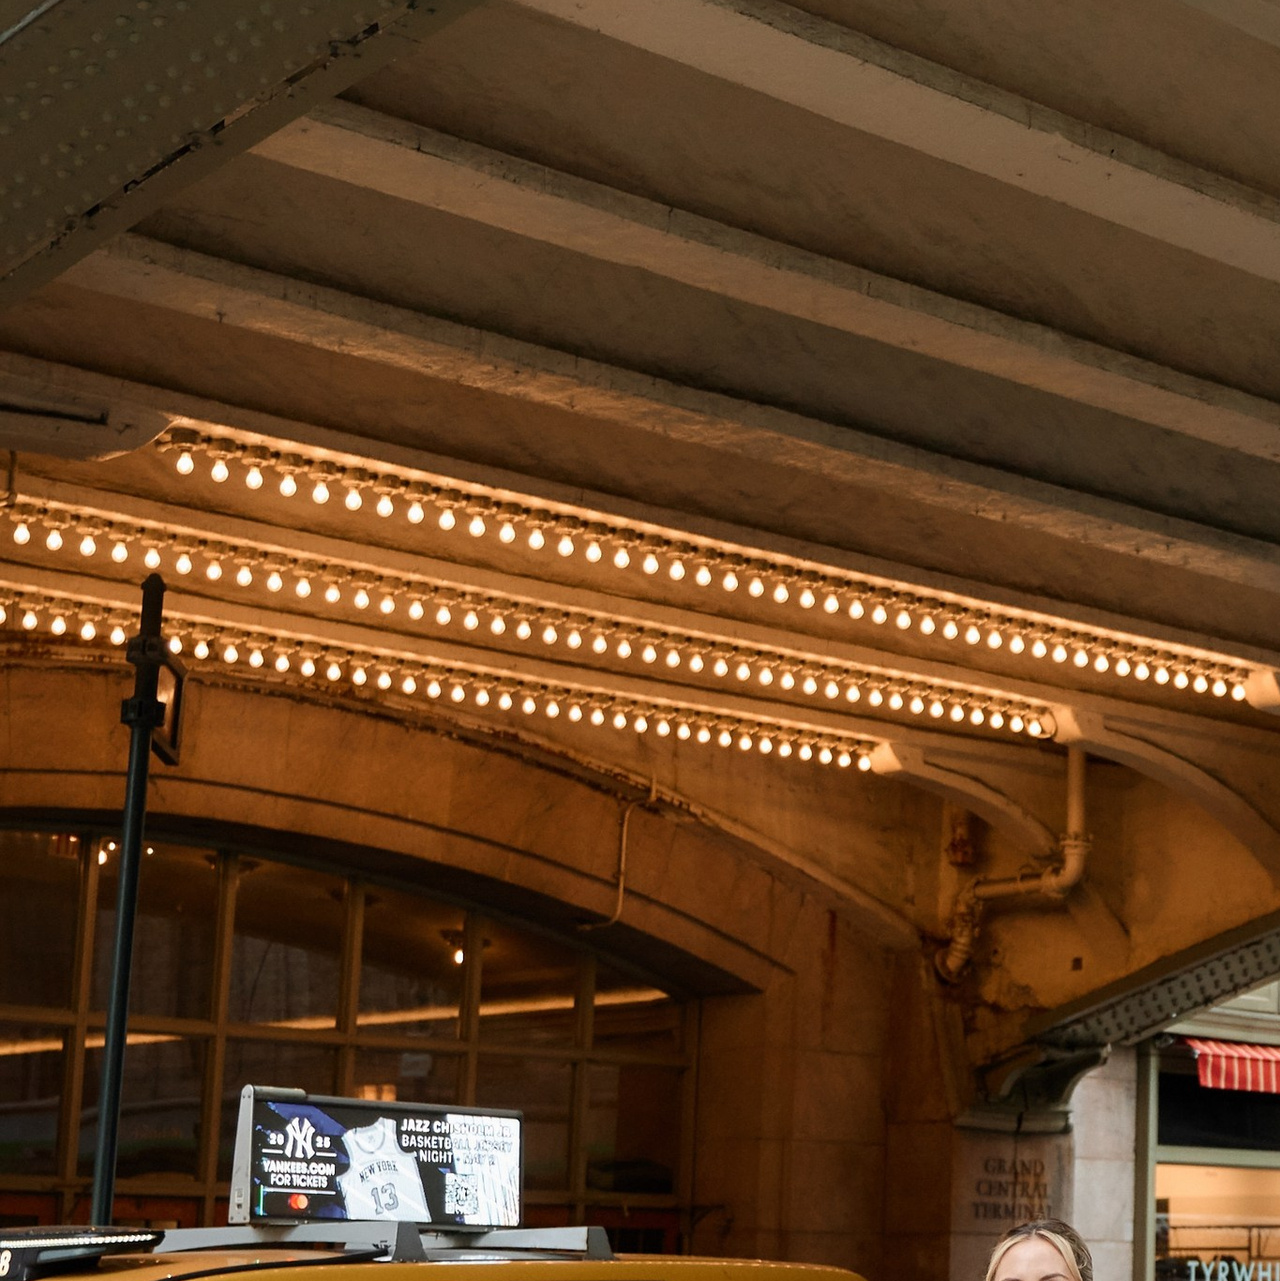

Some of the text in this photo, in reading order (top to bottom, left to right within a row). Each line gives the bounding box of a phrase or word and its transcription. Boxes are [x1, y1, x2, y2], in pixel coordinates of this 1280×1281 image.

[401, 1118, 431, 1133] JAZZ
[433, 1120, 494, 1138] CHISHOLM
[401, 1134, 470, 1151] BASKETBALL
[419, 1150, 454, 1164] NIGHT
[263, 1160, 336, 1176] YANKEES.COM
[359, 1160, 399, 1183] NEW YORK
[984, 1158, 1045, 1176] GRAND
[270, 1174, 328, 1189] FOR TICKETS
[975, 1179, 1048, 1199] CENTRAL
[371, 1182, 399, 1215] 13
